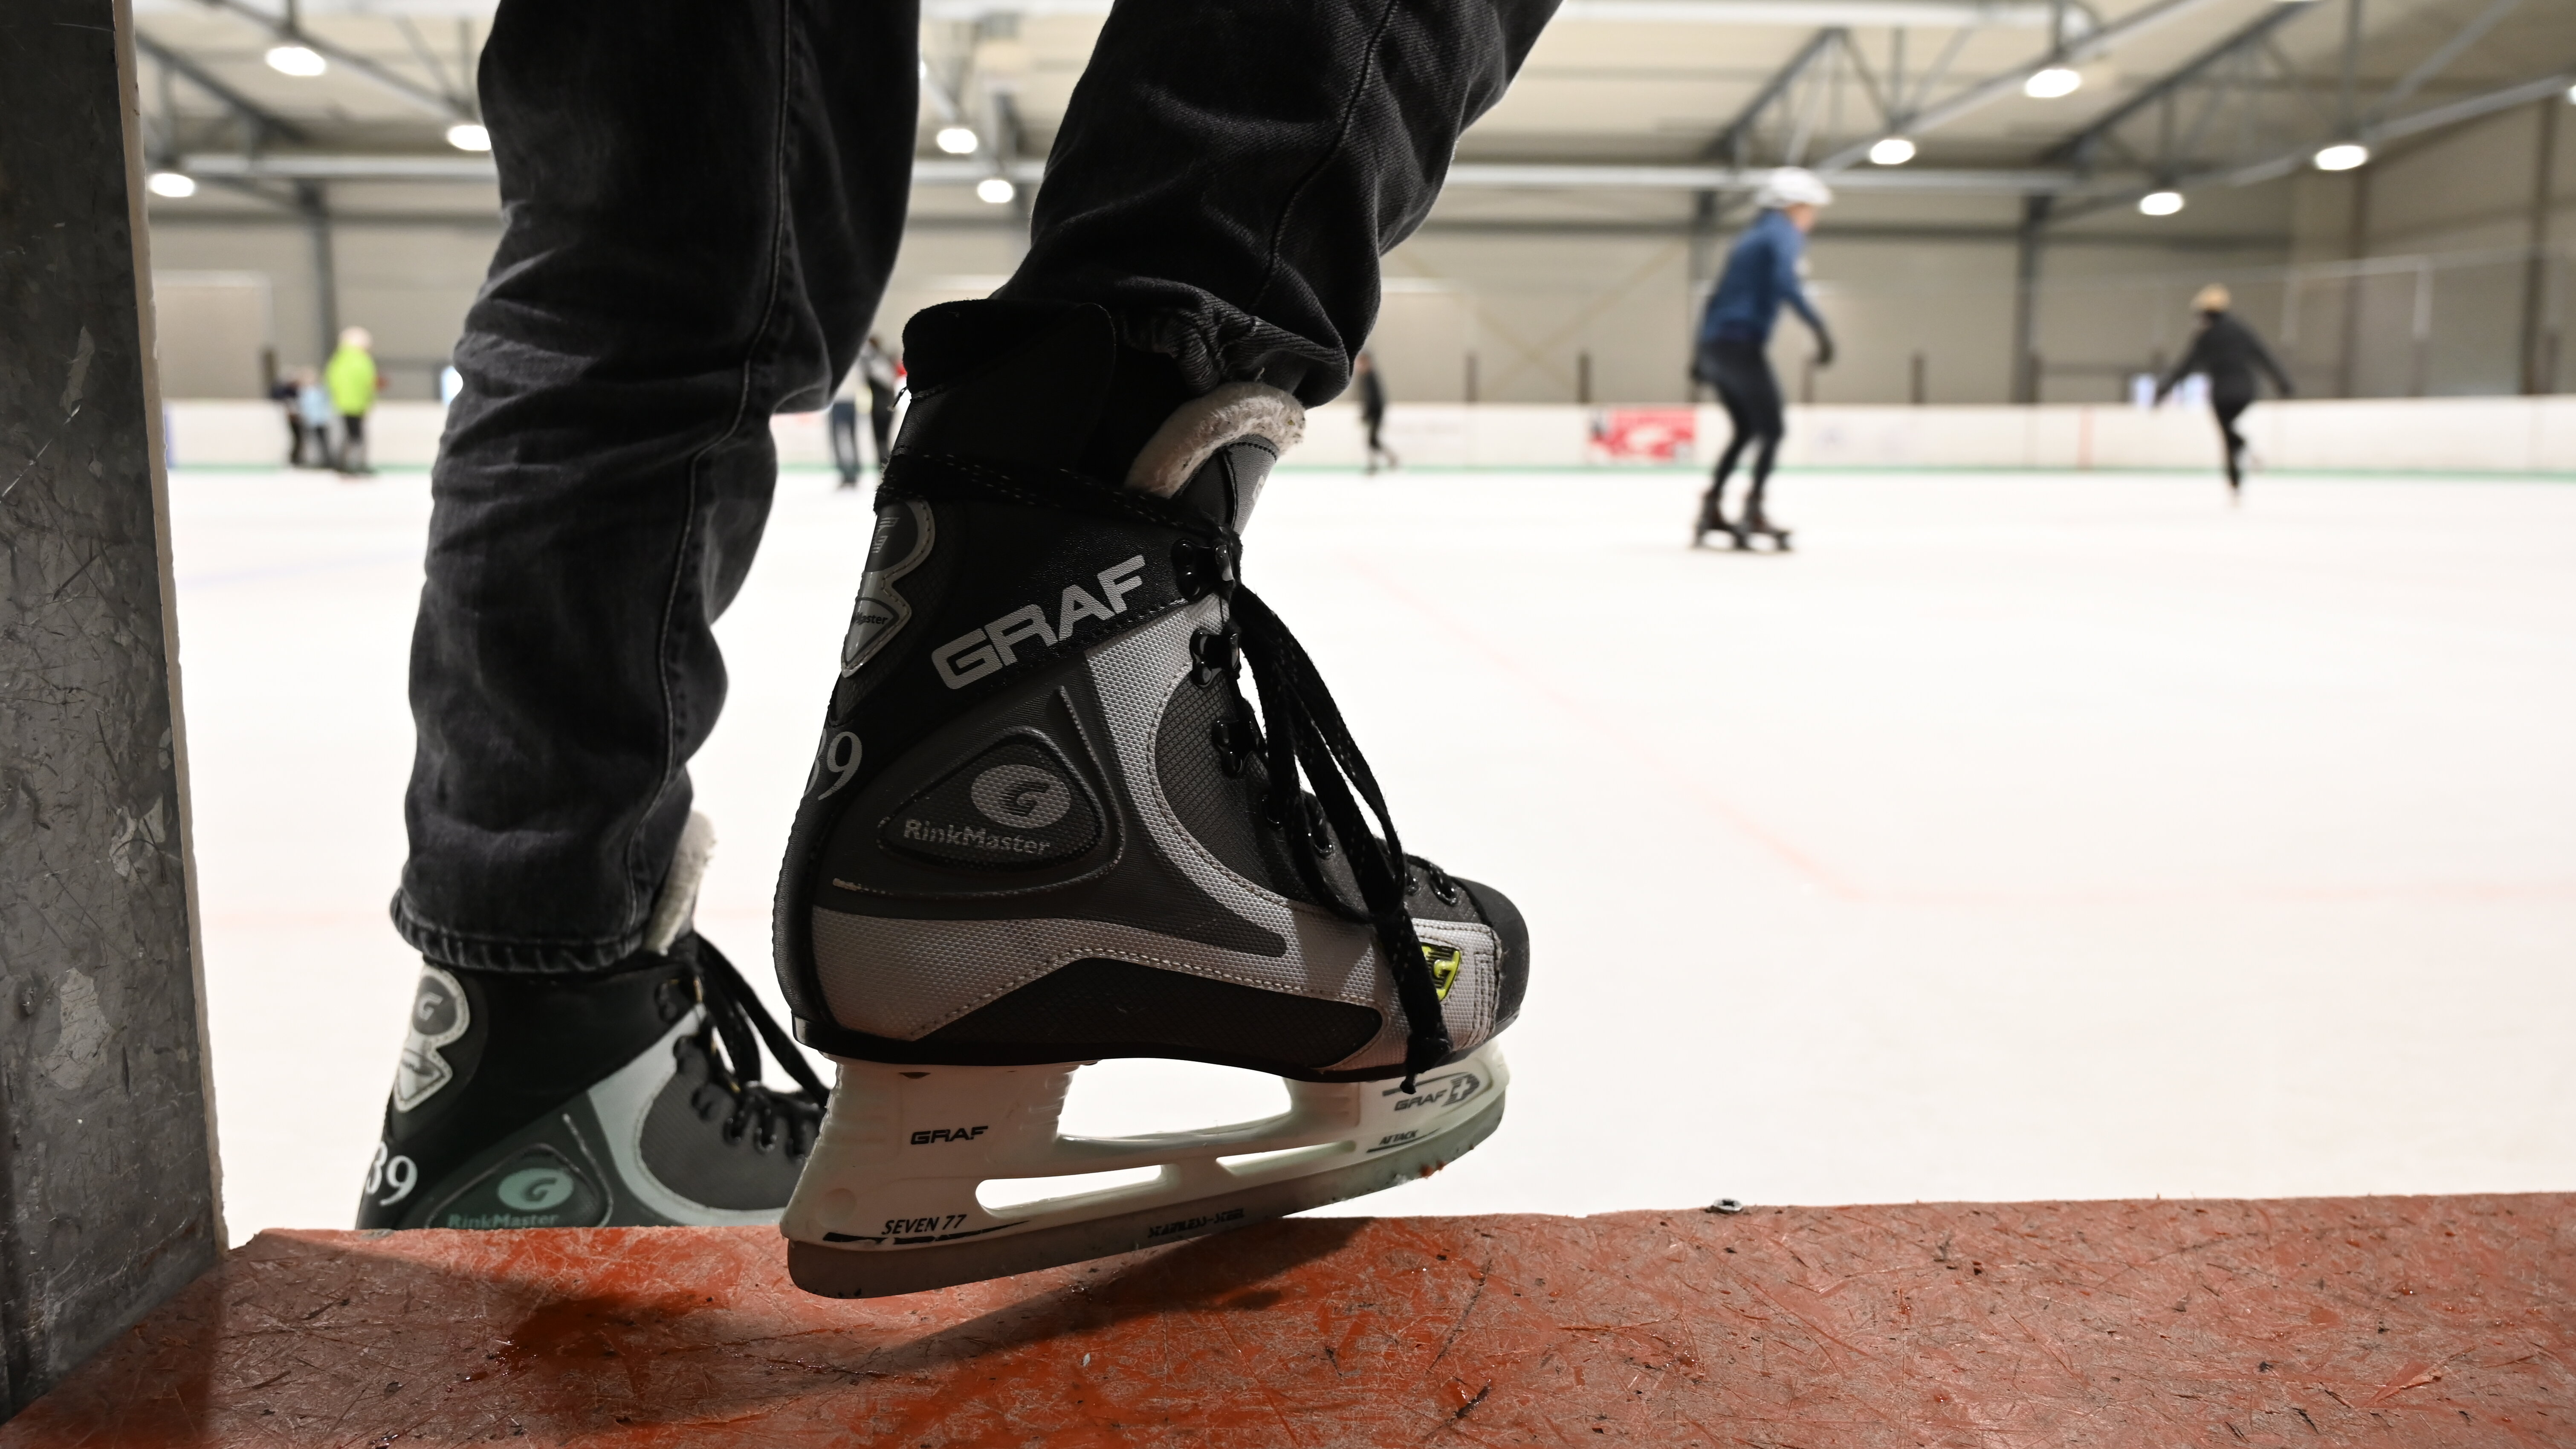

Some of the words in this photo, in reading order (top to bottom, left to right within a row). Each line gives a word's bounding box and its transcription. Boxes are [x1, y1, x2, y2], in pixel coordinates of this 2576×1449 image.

[931, 554, 1146, 690] GRAF
[903, 818, 1051, 855] RinkMaster
[1394, 1088, 1447, 1111] GRAF
[910, 1125, 989, 1145] GRAF
[1379, 1129, 1418, 1145] ATTACK
[881, 1216, 940, 1235] SEVEN
[941, 1214, 967, 1230] 77
